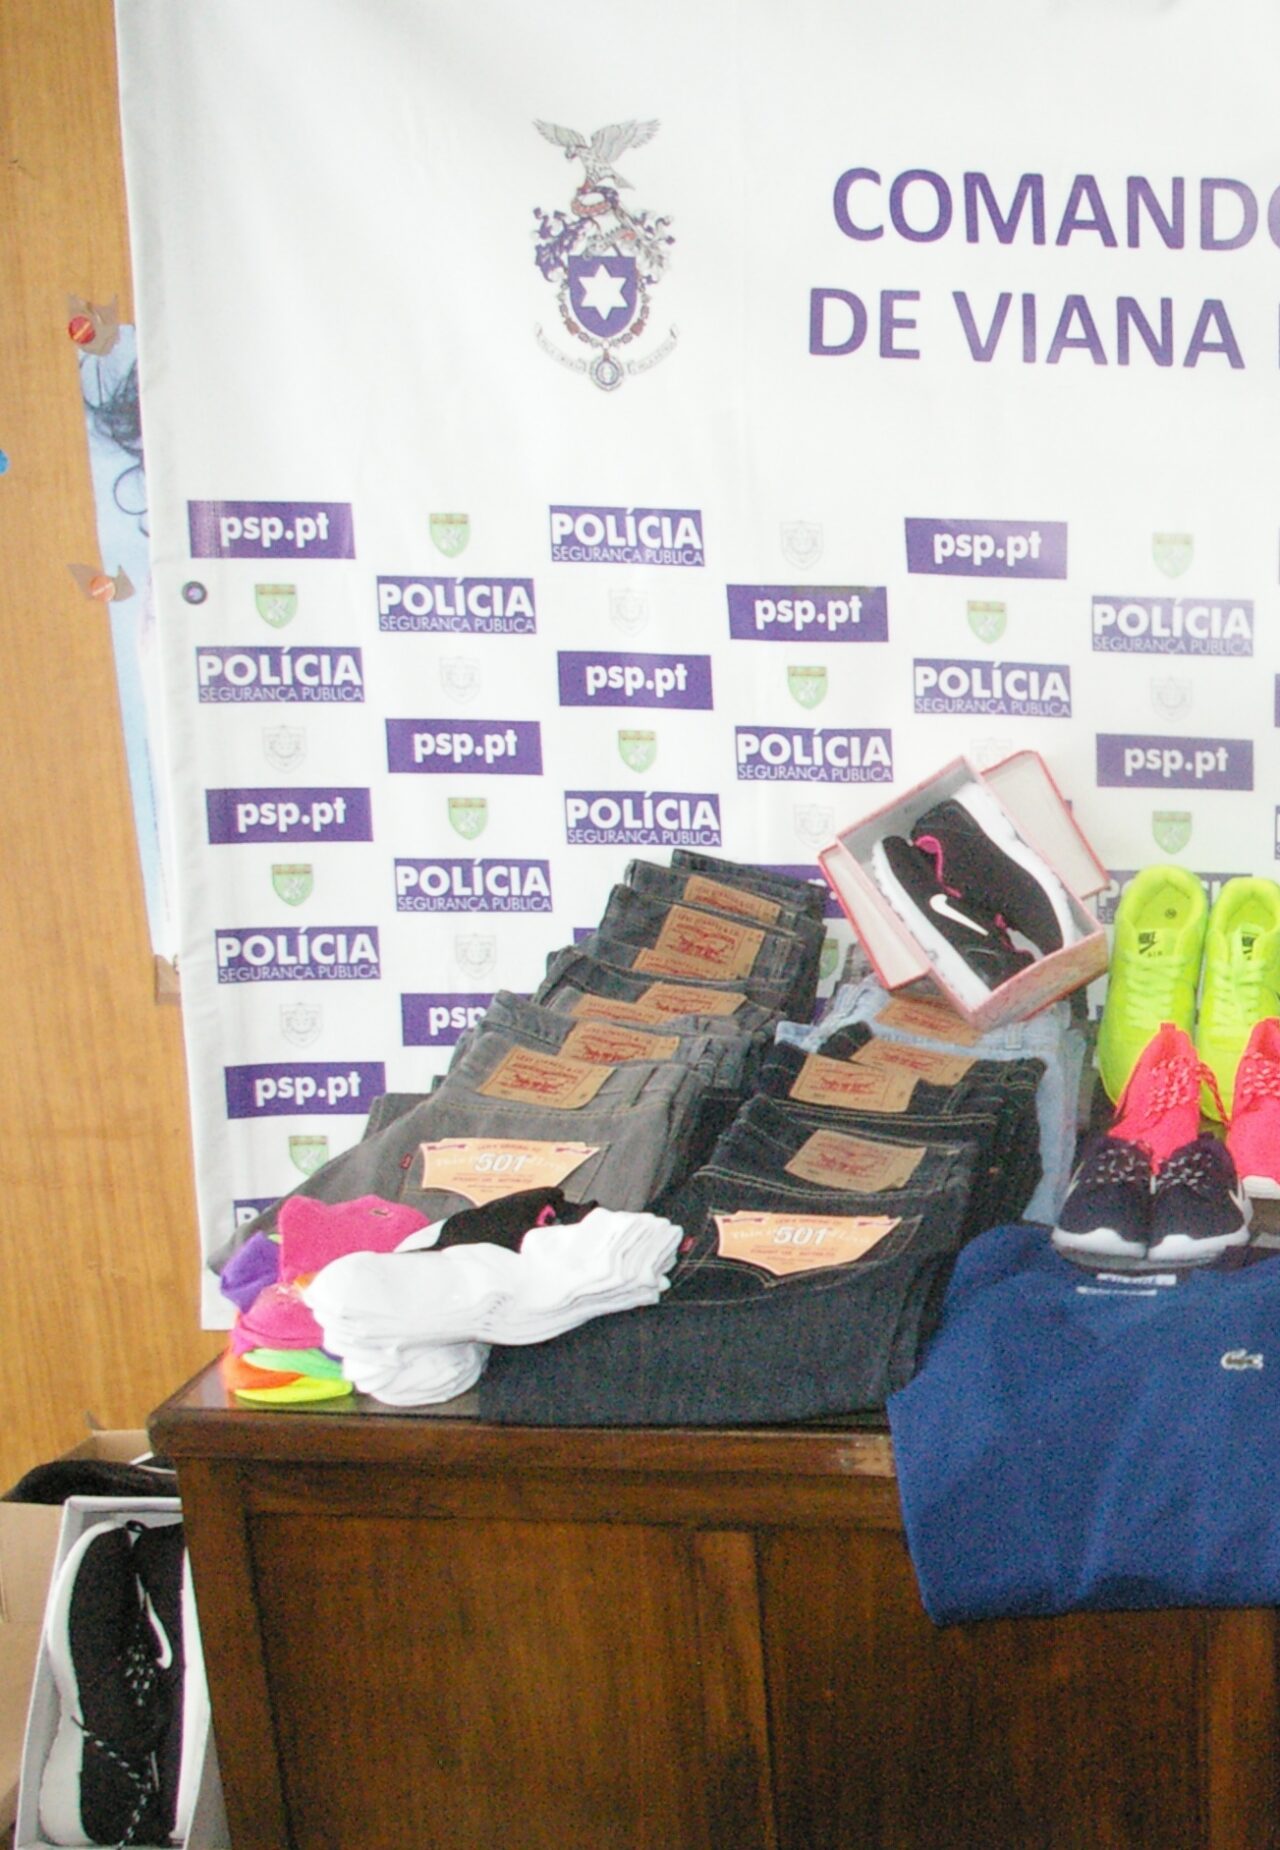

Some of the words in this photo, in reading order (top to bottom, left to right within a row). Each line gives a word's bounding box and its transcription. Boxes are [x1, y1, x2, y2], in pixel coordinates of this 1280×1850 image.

[809, 286, 921, 360] DE
[953, 290, 1246, 370] VIANA
[219, 512, 329, 547] psp.pt
[552, 508, 701, 549] POLÍCIA
[553, 546, 642, 563] SEGURANÇA
[934, 530, 1042, 566] psp.pt
[379, 577, 533, 616] POLÍCIA
[755, 595, 862, 631] psp.pt
[381, 616, 472, 632] SEGURANÇA
[1094, 598, 1251, 639] POLÍCIA
[1094, 636, 1187, 653] SEGURANÇA
[199, 647, 360, 685] POLÍCIA
[586, 664, 687, 698] psp.pt
[915, 662, 1069, 701] POLÍCIA
[201, 687, 296, 702] SEGURANÇA
[916, 698, 1007, 714] SEGURANÇA
[414, 730, 517, 763] psp.pt
[737, 728, 890, 765] POLÍCIA
[1125, 747, 1228, 778] psp.pt
[739, 765, 829, 780] SEGURANÇA
[237, 797, 346, 832] psp.pt
[566, 793, 718, 830] POLÍCIA
[568, 830, 658, 844] SEGURANÇA
[396, 859, 549, 896] POLÍCIA
[398, 896, 489, 910] SEGURANÇA
[218, 928, 377, 966] POLÍCIA
[220, 967, 314, 981] SEGURANÇA
[256, 1071, 361, 1106] psp.pt
[475, 1152, 528, 1172] 501
[774, 1226, 827, 1245] 501
